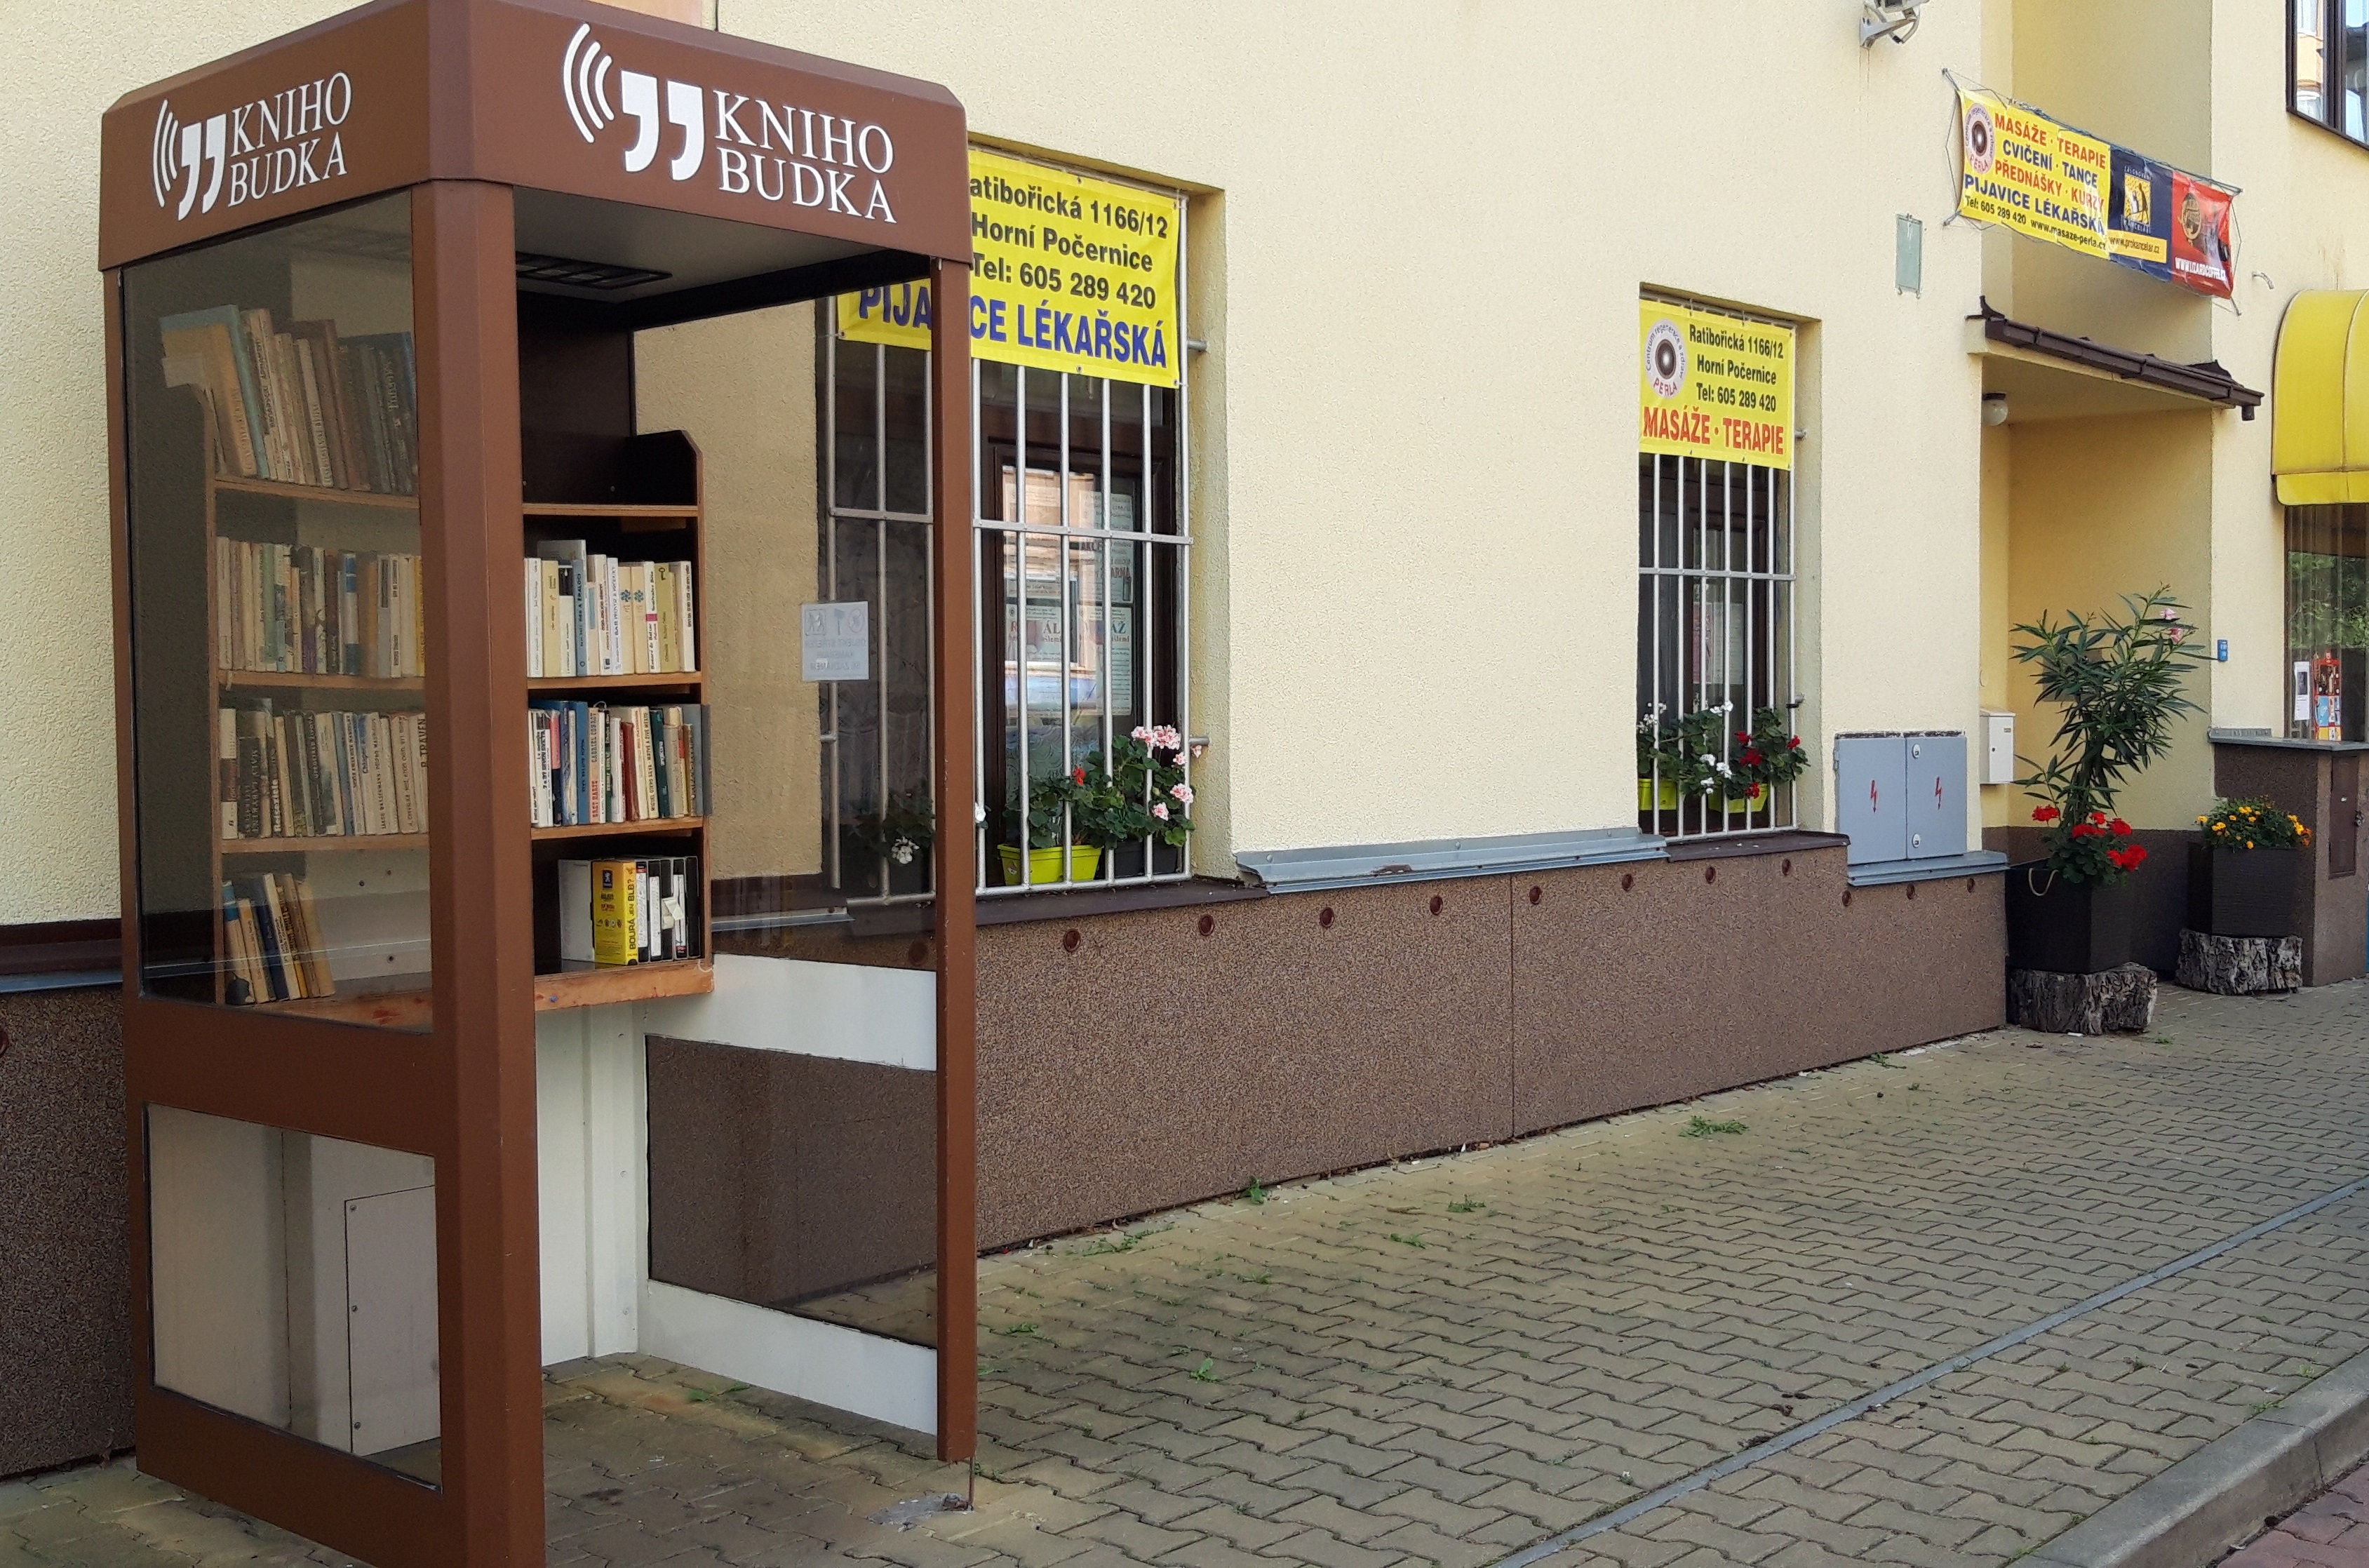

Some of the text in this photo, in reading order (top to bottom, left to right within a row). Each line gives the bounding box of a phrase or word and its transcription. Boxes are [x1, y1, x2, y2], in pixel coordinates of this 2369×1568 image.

[229, 72, 351, 158] KNIHO
[712, 89, 894, 174] KNIHO
[1994, 112, 2107, 170] MASÁŽE TERAPIE
[227, 131, 348, 208] BUDKA
[716, 146, 898, 224] BUDKA
[1994, 156, 2105, 214] PŘEDNÁŠKY KURZY
[2003, 138, 2098, 189] CVIČENÍ TANCE
[969, 175, 1169, 240] atibořická 1166/12
[1964, 173, 2105, 236] PIJAVICE LÉKAŘSKÁ
[1964, 194, 1979, 210] Tel:
[1980, 200, 1995, 215] 605
[2012, 211, 2027, 225] 420
[972, 211, 1154, 272] Horní Počernice
[972, 253, 1157, 309] Tel: 605 289 420
[1017, 298, 1167, 369] LÉKAŘSKÁ
[1689, 323, 1785, 360] Ratibořická 1166/12
[1653, 377, 1678, 396] PERLA
[1696, 382, 1777, 413] Tel: 605 289 420
[1697, 354, 1777, 386] Horní Počernice
[1643, 404, 1785, 455] MASÁŽE TERAPIE
[627, 917, 636, 950] BOURÁ
